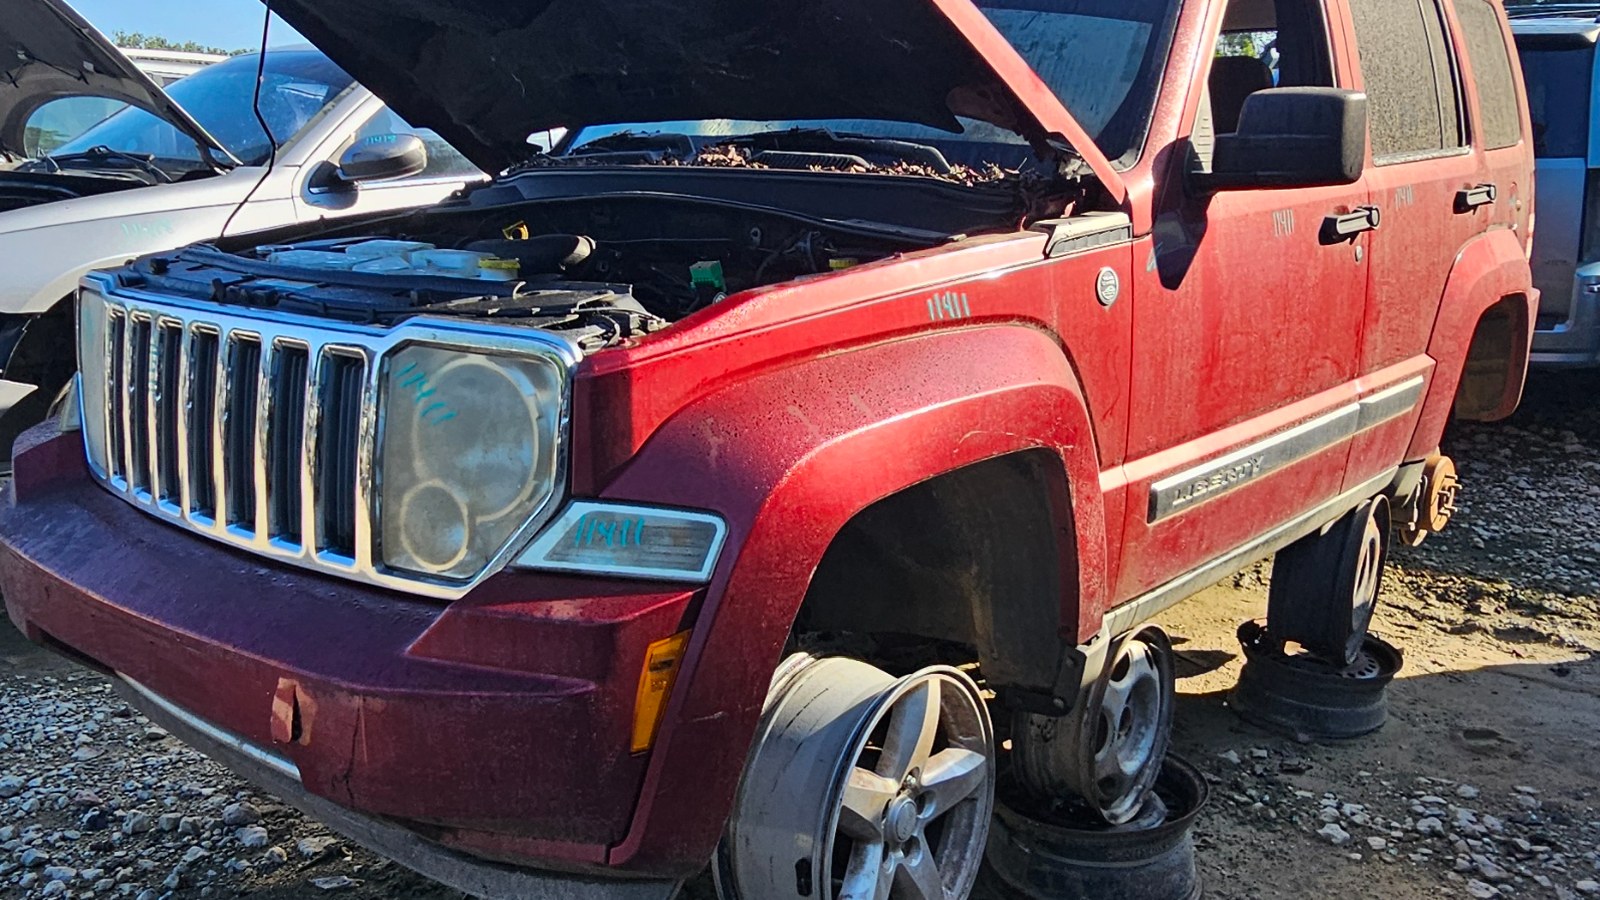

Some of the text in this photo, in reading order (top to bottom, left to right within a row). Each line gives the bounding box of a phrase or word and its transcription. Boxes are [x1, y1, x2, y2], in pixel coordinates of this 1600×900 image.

[927, 291, 970, 320] 11411
[1172, 454, 1264, 506] LIBERTY
[575, 514, 644, 548] 11411
